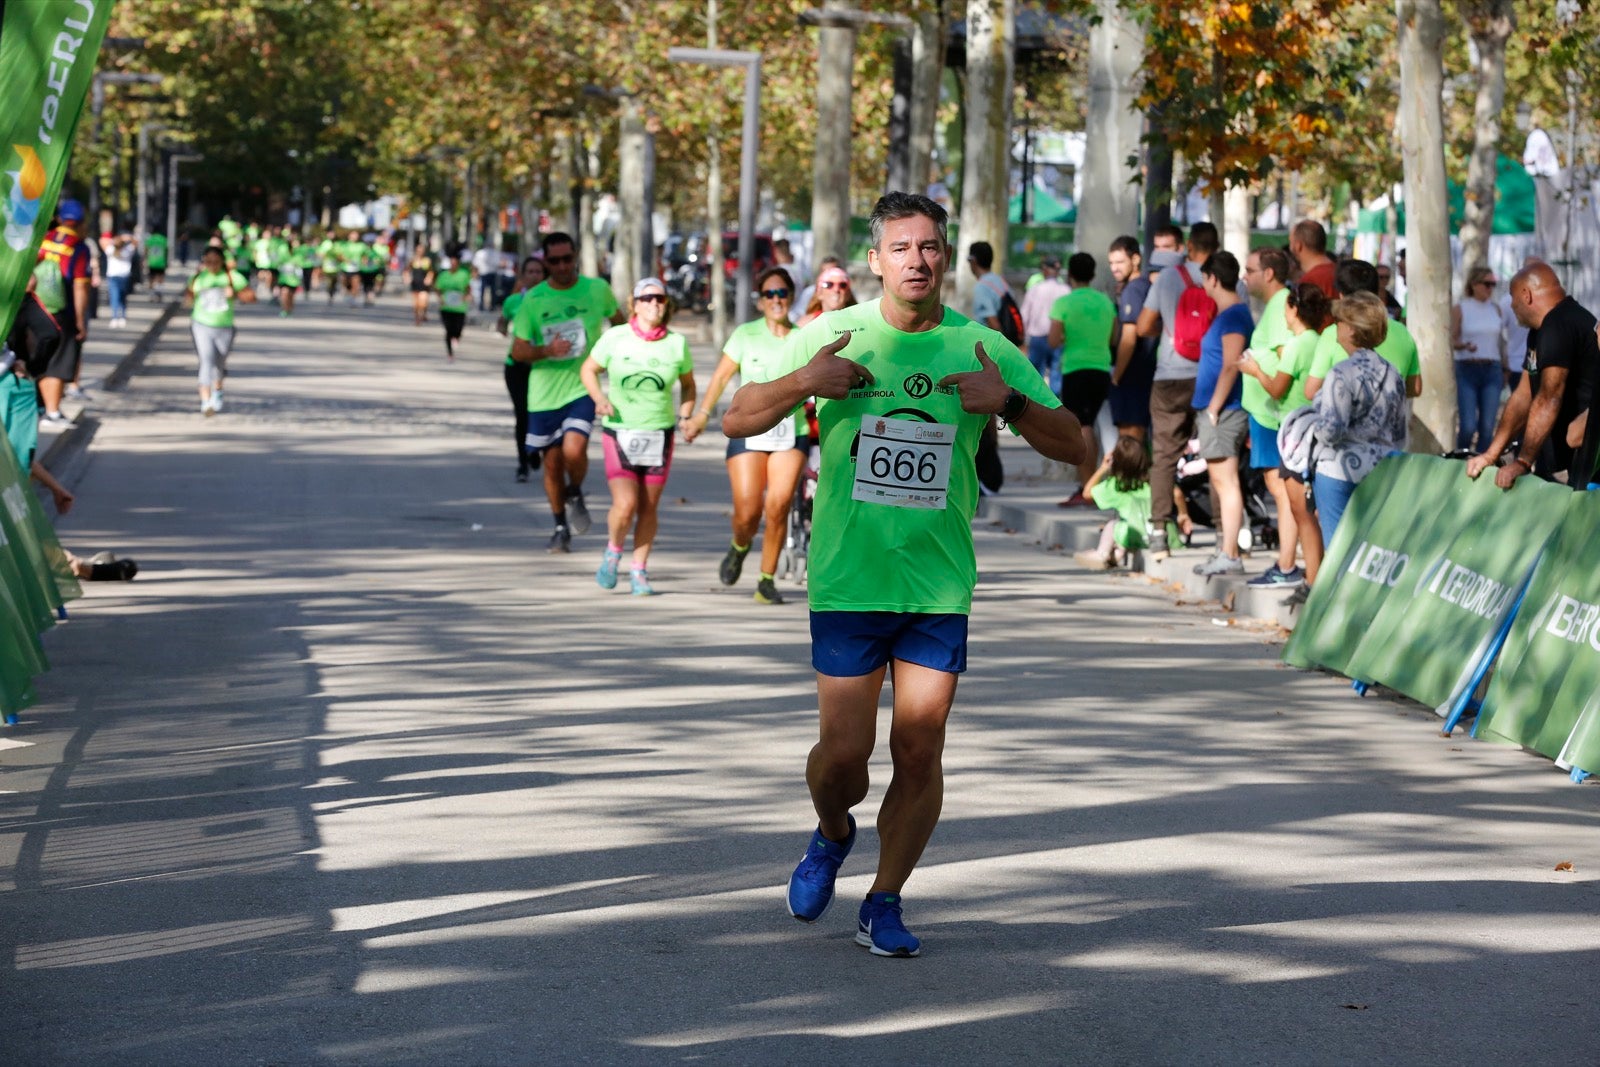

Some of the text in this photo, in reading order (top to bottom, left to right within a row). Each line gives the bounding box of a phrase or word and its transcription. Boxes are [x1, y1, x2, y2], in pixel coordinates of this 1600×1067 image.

[851, 390, 895, 399] IBERDROLA
[628, 438, 651, 453] 97
[870, 446, 937, 483] 666
